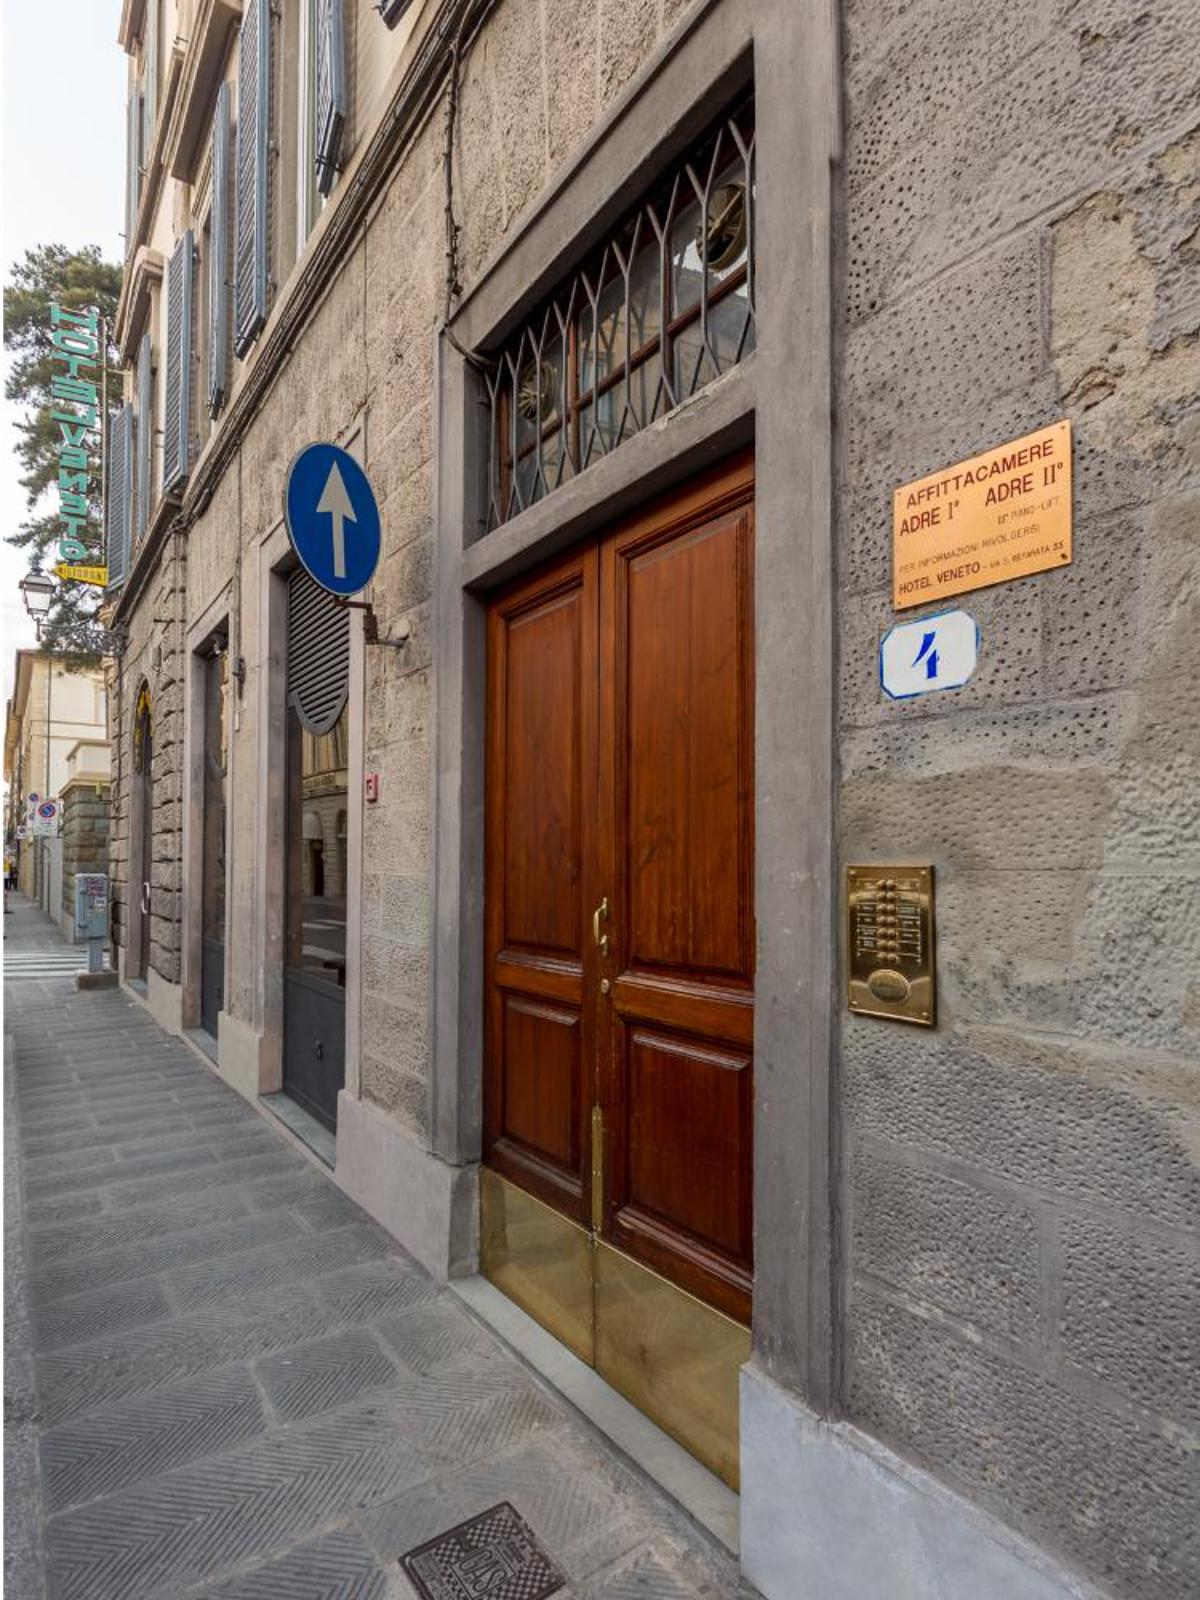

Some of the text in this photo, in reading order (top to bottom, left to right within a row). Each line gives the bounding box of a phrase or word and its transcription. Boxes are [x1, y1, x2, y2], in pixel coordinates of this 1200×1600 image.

[907, 439, 1054, 509] AFFITTACAMERE
[985, 473, 1034, 507] ADRE
[900, 507, 941, 536] ADRE
[899, 576, 932, 594] HOTEL
[937, 561, 980, 584] VENETO
[911, 631, 939, 679] 4
[460, 1549, 507, 1593] GAS
